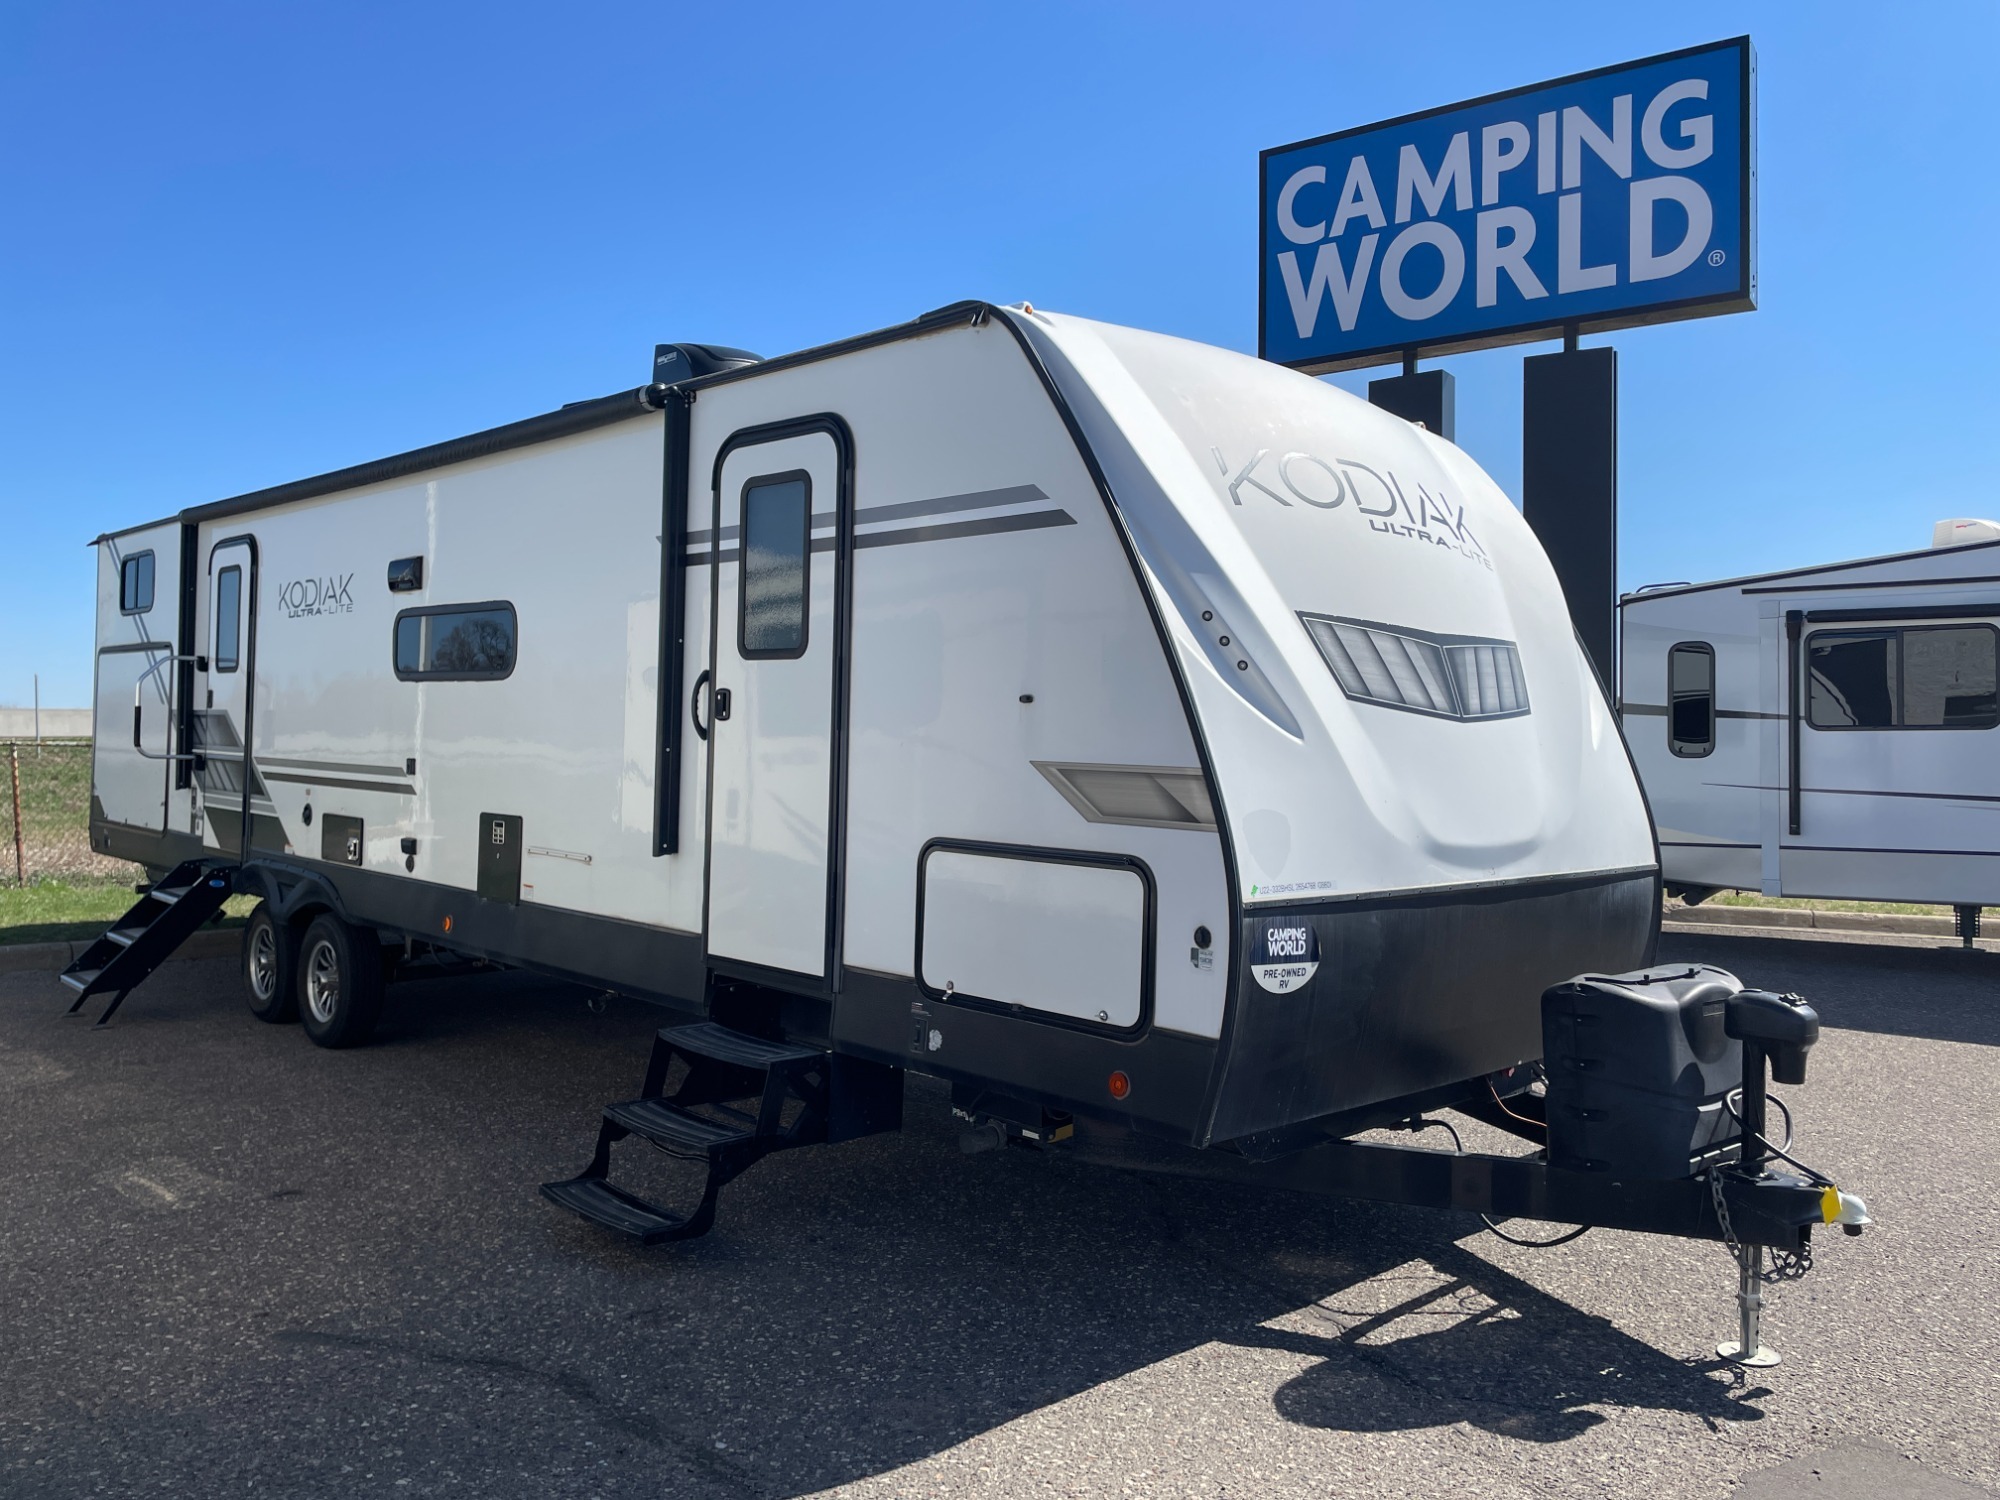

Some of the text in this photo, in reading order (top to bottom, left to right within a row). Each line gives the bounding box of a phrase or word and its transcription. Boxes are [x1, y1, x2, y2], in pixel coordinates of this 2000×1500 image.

[1277, 79, 1713, 244] CAMPING
[1277, 175, 1713, 338] WORLD
[1210, 446, 1487, 556] KODIAK
[1368, 519, 1493, 571] ULTRA-LITE
[278, 573, 354, 611] KODIAK
[288, 603, 354, 618] ULTRA-LITE
[1267, 927, 1306, 941] CAMPING
[1267, 940, 1306, 956] WORLD
[1263, 968, 1307, 979] PRE-OWNED
[1278, 979, 1290, 989] RV
